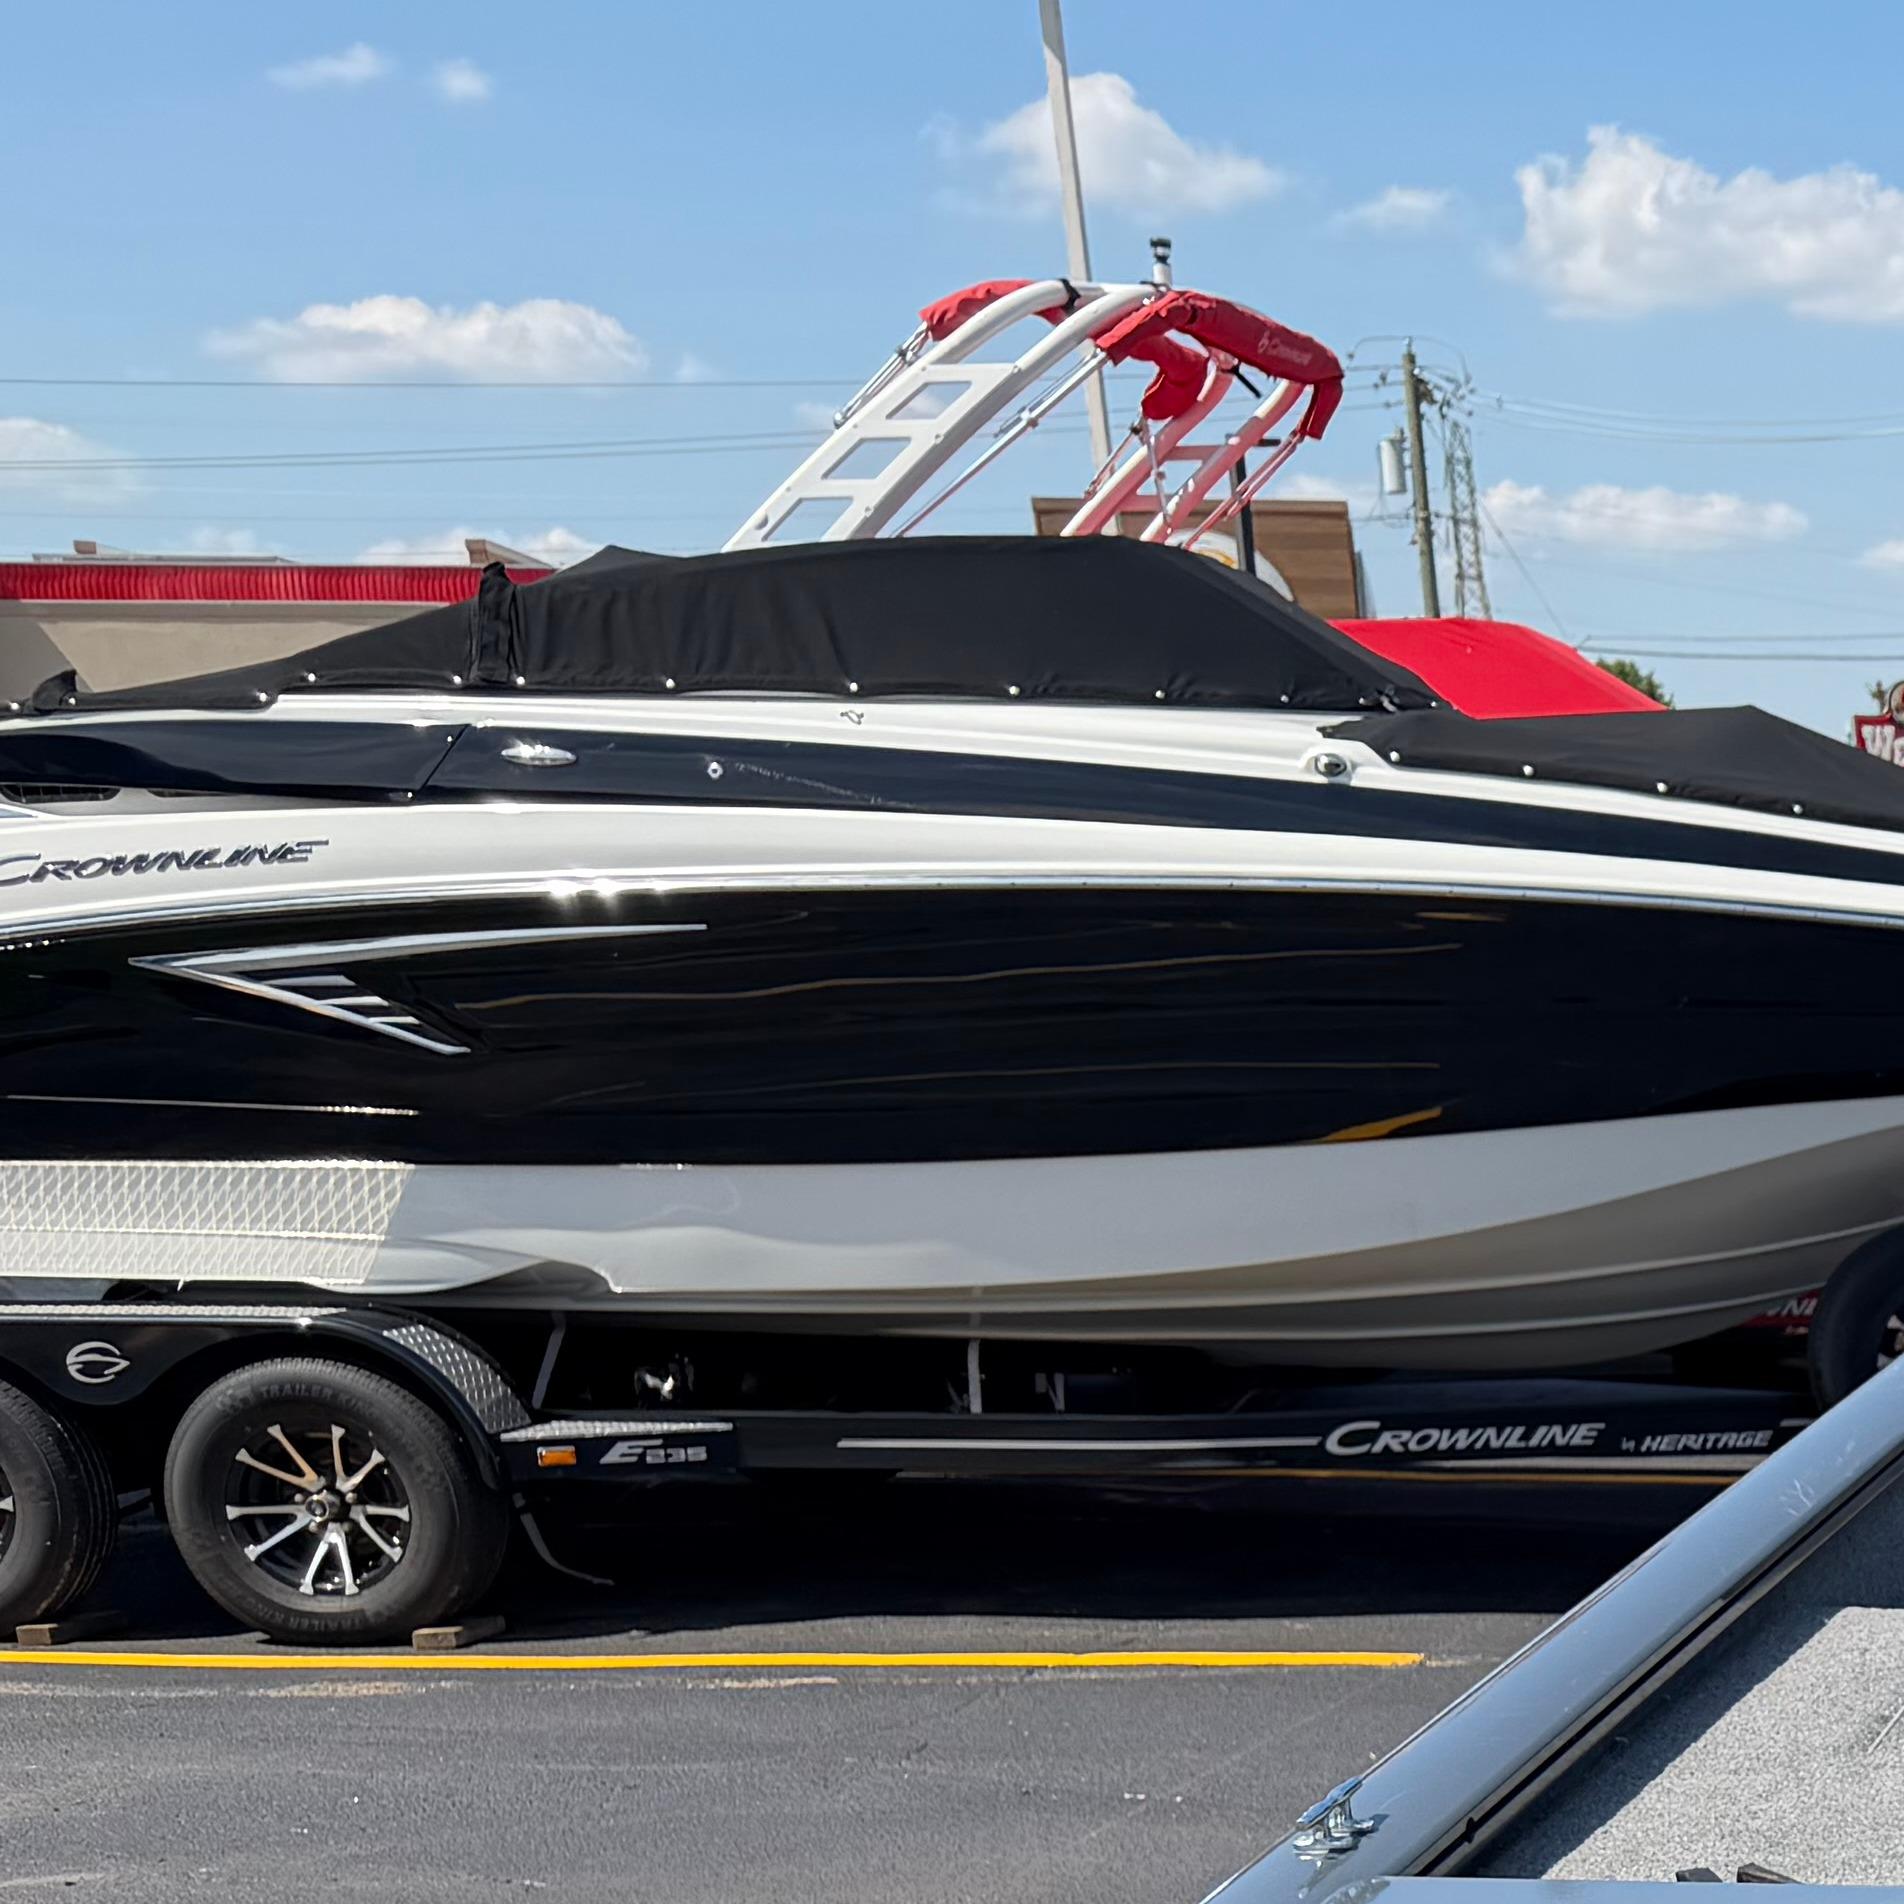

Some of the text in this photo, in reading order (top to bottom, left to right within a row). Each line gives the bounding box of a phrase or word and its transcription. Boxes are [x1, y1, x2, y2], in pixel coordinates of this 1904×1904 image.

[0, 840, 329, 887] CROWNLINE
[1324, 1420, 1606, 1456] CROWNLINE
[1641, 1430, 1774, 1452] HERITAGE
